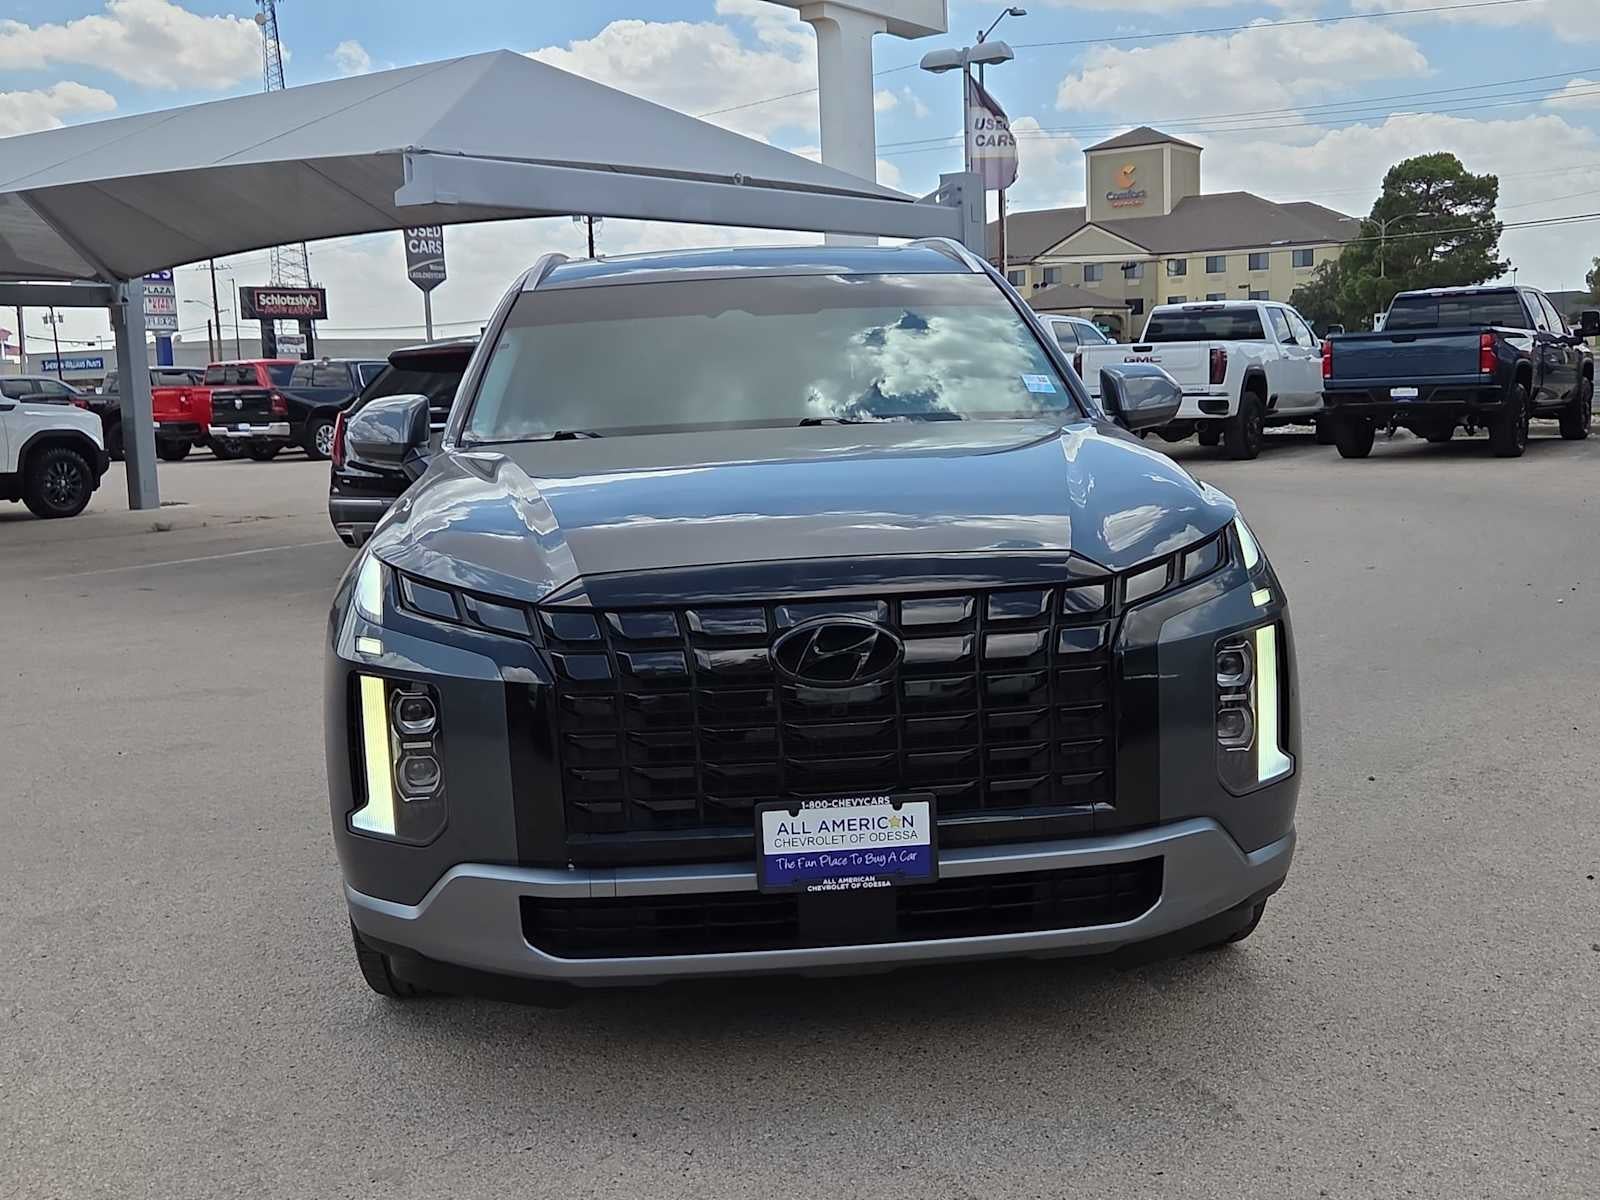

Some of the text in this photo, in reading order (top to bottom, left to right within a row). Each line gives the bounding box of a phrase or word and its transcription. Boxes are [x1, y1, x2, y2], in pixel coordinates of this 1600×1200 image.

[975, 134, 1016, 147] CARS
[408, 226, 440, 238] USED
[409, 239, 442, 254] CARS
[260, 294, 317, 307] Schlotzsky's
[801, 796, 890, 809] 1-800-CHEVYCARS
[777, 822, 811, 836] ALL
[774, 830, 918, 848] CHEVROLET OF ODESSA
[776, 850, 918, 870] The Fun Place To Buy A Car
[838, 876, 876, 884] AMERICAN
[807, 884, 849, 892] CHEVROLET
